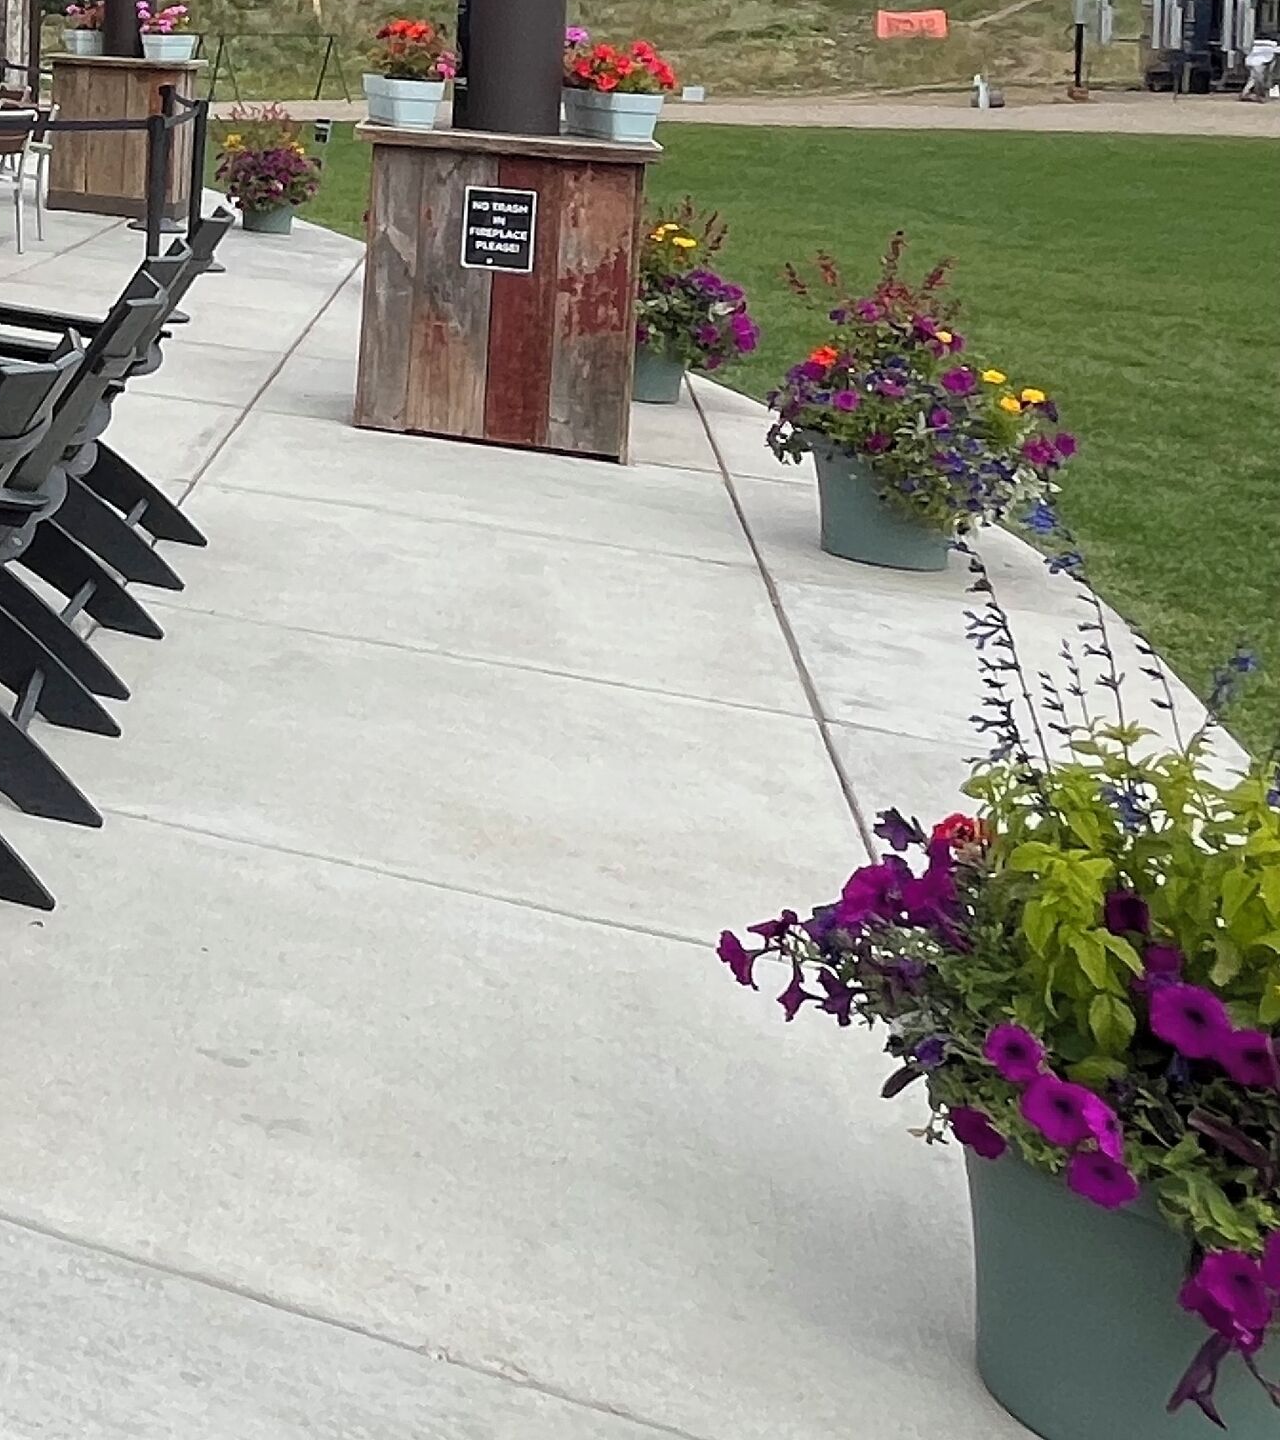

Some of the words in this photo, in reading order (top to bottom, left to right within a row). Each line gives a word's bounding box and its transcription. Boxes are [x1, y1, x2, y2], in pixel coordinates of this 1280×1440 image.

[472, 201, 490, 211] NO
[492, 202, 529, 214] TRASH
[492, 216, 507, 227] IN
[469, 226, 528, 241] FIREPLACE
